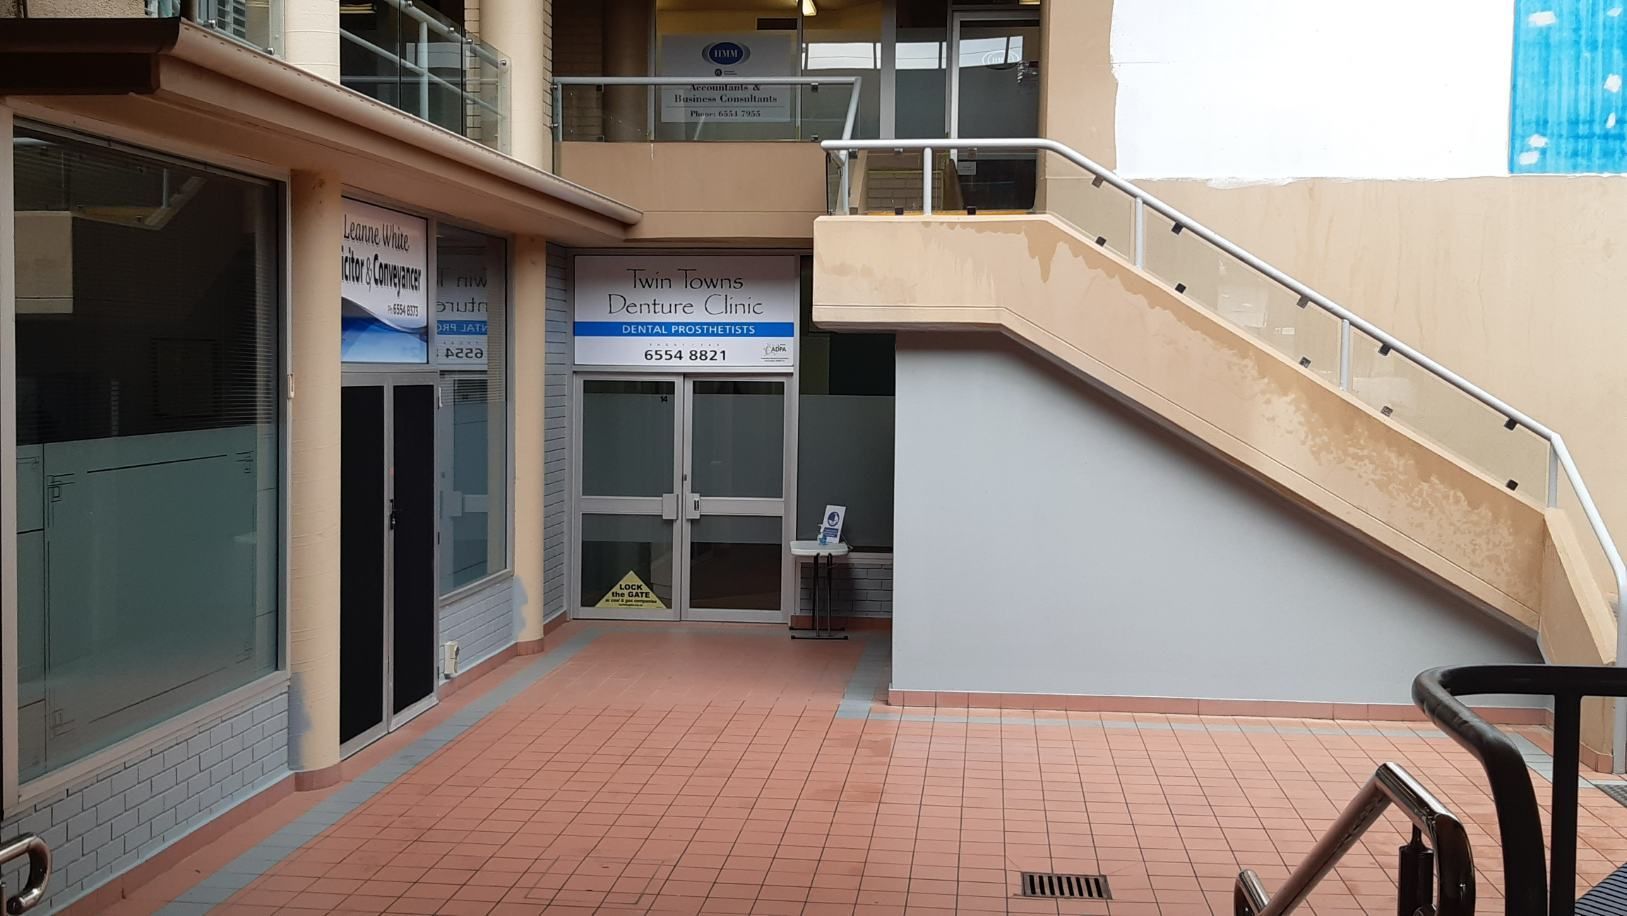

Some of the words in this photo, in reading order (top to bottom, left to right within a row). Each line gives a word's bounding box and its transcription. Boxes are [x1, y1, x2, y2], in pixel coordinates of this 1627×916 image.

[714, 49, 738, 58] HMM
[690, 84, 748, 92] Accountants
[752, 84, 761, 92] &
[674, 94, 717, 103] Business
[720, 94, 777, 103] Consultants
[343, 213, 380, 246] Leanne
[382, 223, 410, 252] White
[341, 245, 365, 284] icitor
[366, 256, 373, 293] &
[373, 253, 422, 297] Conveyancer
[626, 268, 672, 290] Twin
[677, 268, 744, 290] Towns
[607, 293, 695, 315] Denture
[704, 293, 764, 315] Clinic
[393, 303, 406, 316] 6554
[406, 304, 419, 317] 8373
[622, 325, 668, 334] DENTAL
[671, 325, 756, 334] PROSTHETISTS
[644, 349, 684, 361] 6554
[688, 349, 727, 361] 8821
[619, 583, 643, 591] LOCK
[627, 591, 651, 599] GATE
